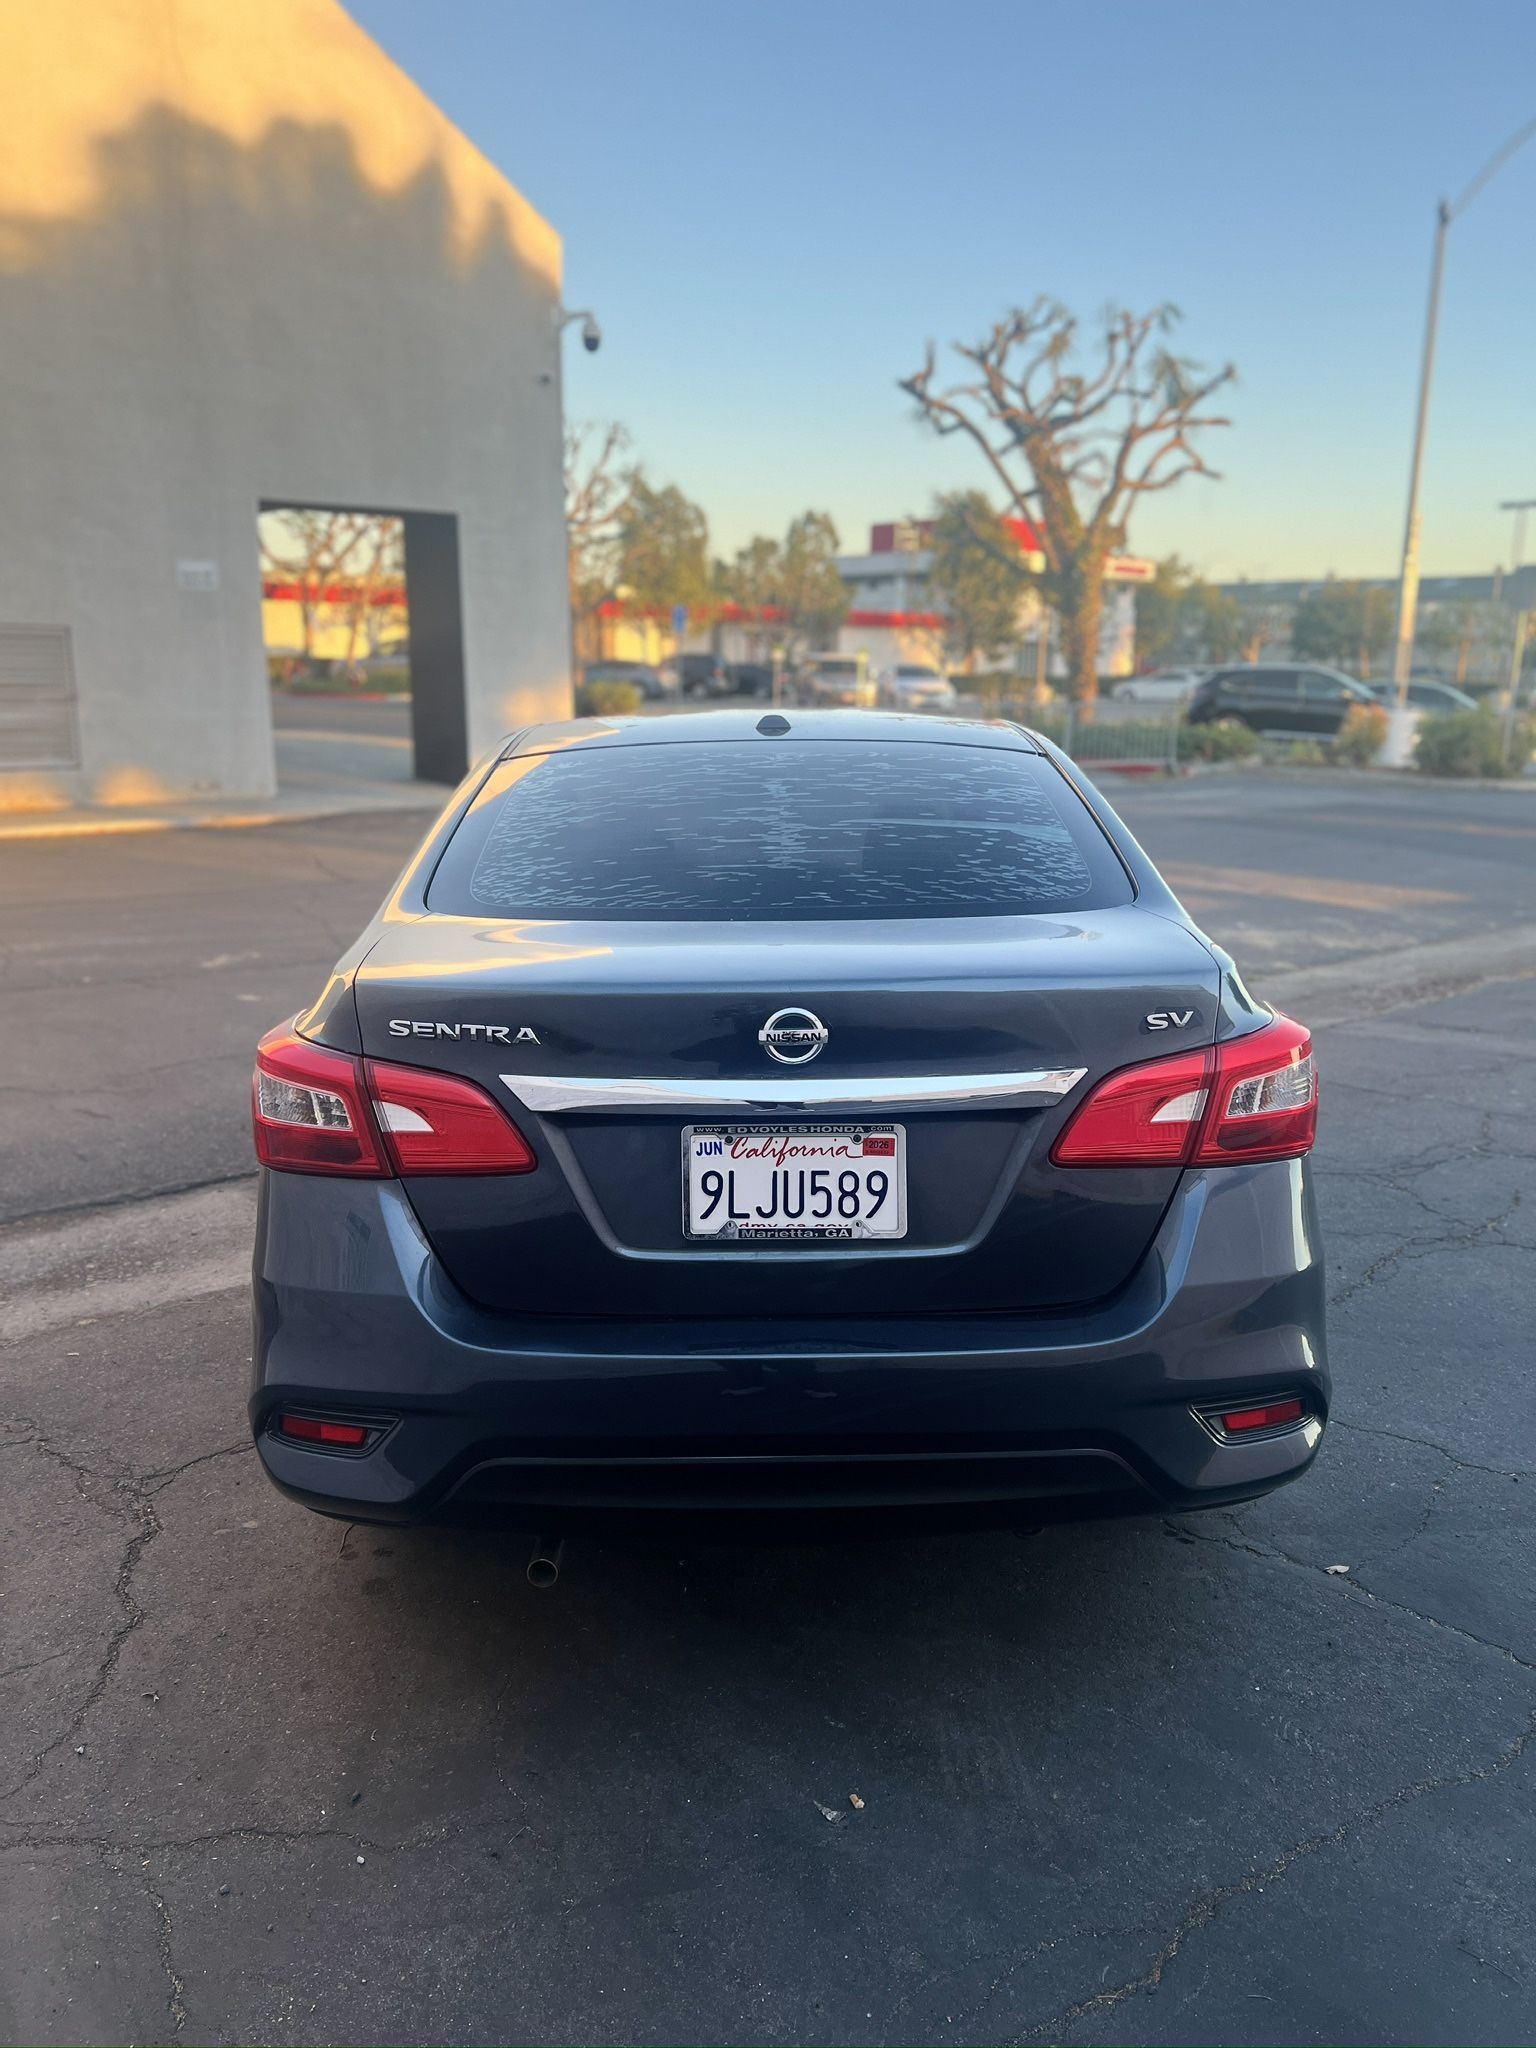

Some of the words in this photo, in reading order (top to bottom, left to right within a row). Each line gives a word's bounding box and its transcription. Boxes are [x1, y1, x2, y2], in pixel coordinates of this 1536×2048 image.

[1146, 1010, 1194, 1031] SV
[388, 1018, 541, 1046] SENTRA
[765, 1032, 821, 1043] NISSAN
[696, 1141, 723, 1157] JUN
[730, 1136, 863, 1167] California
[868, 1140, 889, 1149] 2026
[700, 1170, 889, 1220] 9LJU589
[741, 1229, 819, 1238] Marietta,
[825, 1228, 850, 1238] GA
